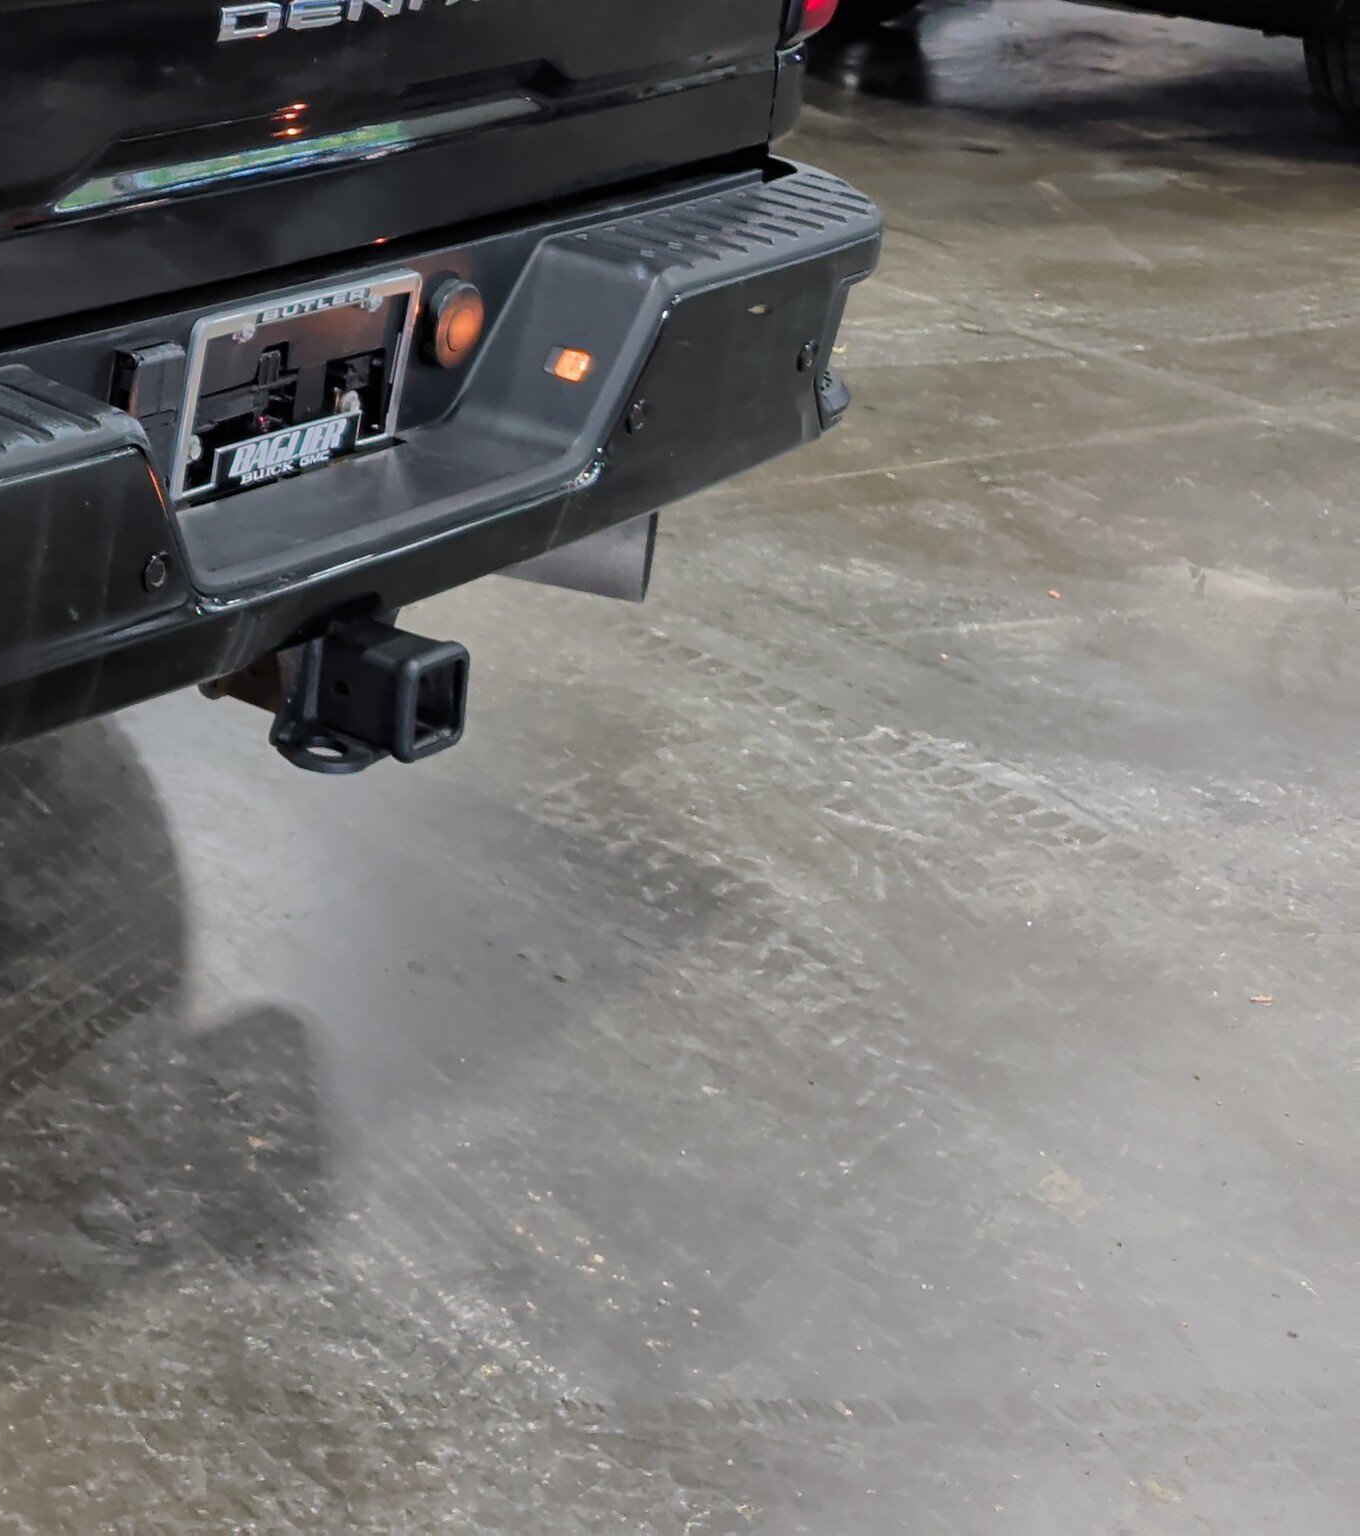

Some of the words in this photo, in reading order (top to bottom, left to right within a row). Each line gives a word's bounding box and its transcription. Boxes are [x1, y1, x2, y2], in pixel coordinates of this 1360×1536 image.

[261, 289, 366, 322] BUTLER
[229, 417, 347, 477] BAGLIER
[240, 462, 294, 485] BUICK
[300, 450, 330, 467] GMC
